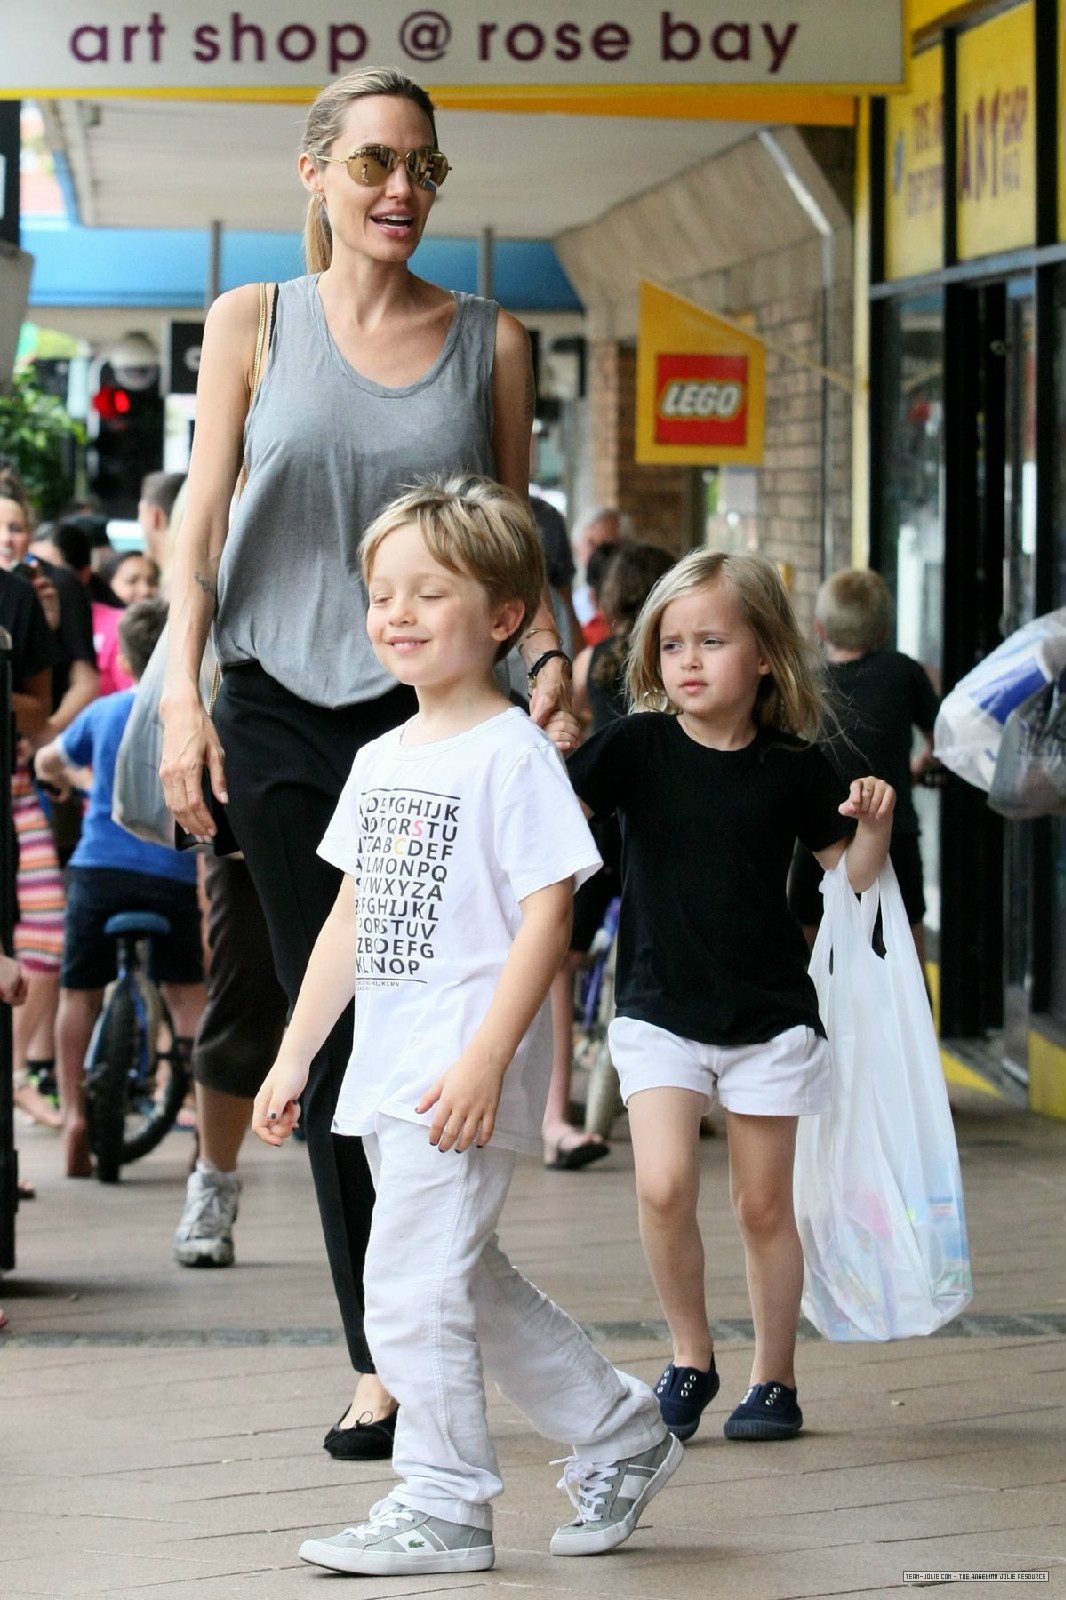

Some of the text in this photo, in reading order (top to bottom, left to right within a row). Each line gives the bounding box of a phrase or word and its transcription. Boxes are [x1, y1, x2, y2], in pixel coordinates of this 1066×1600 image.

[70, 11, 798, 74] art shop @ rose bay
[662, 381, 741, 417] LEGO
